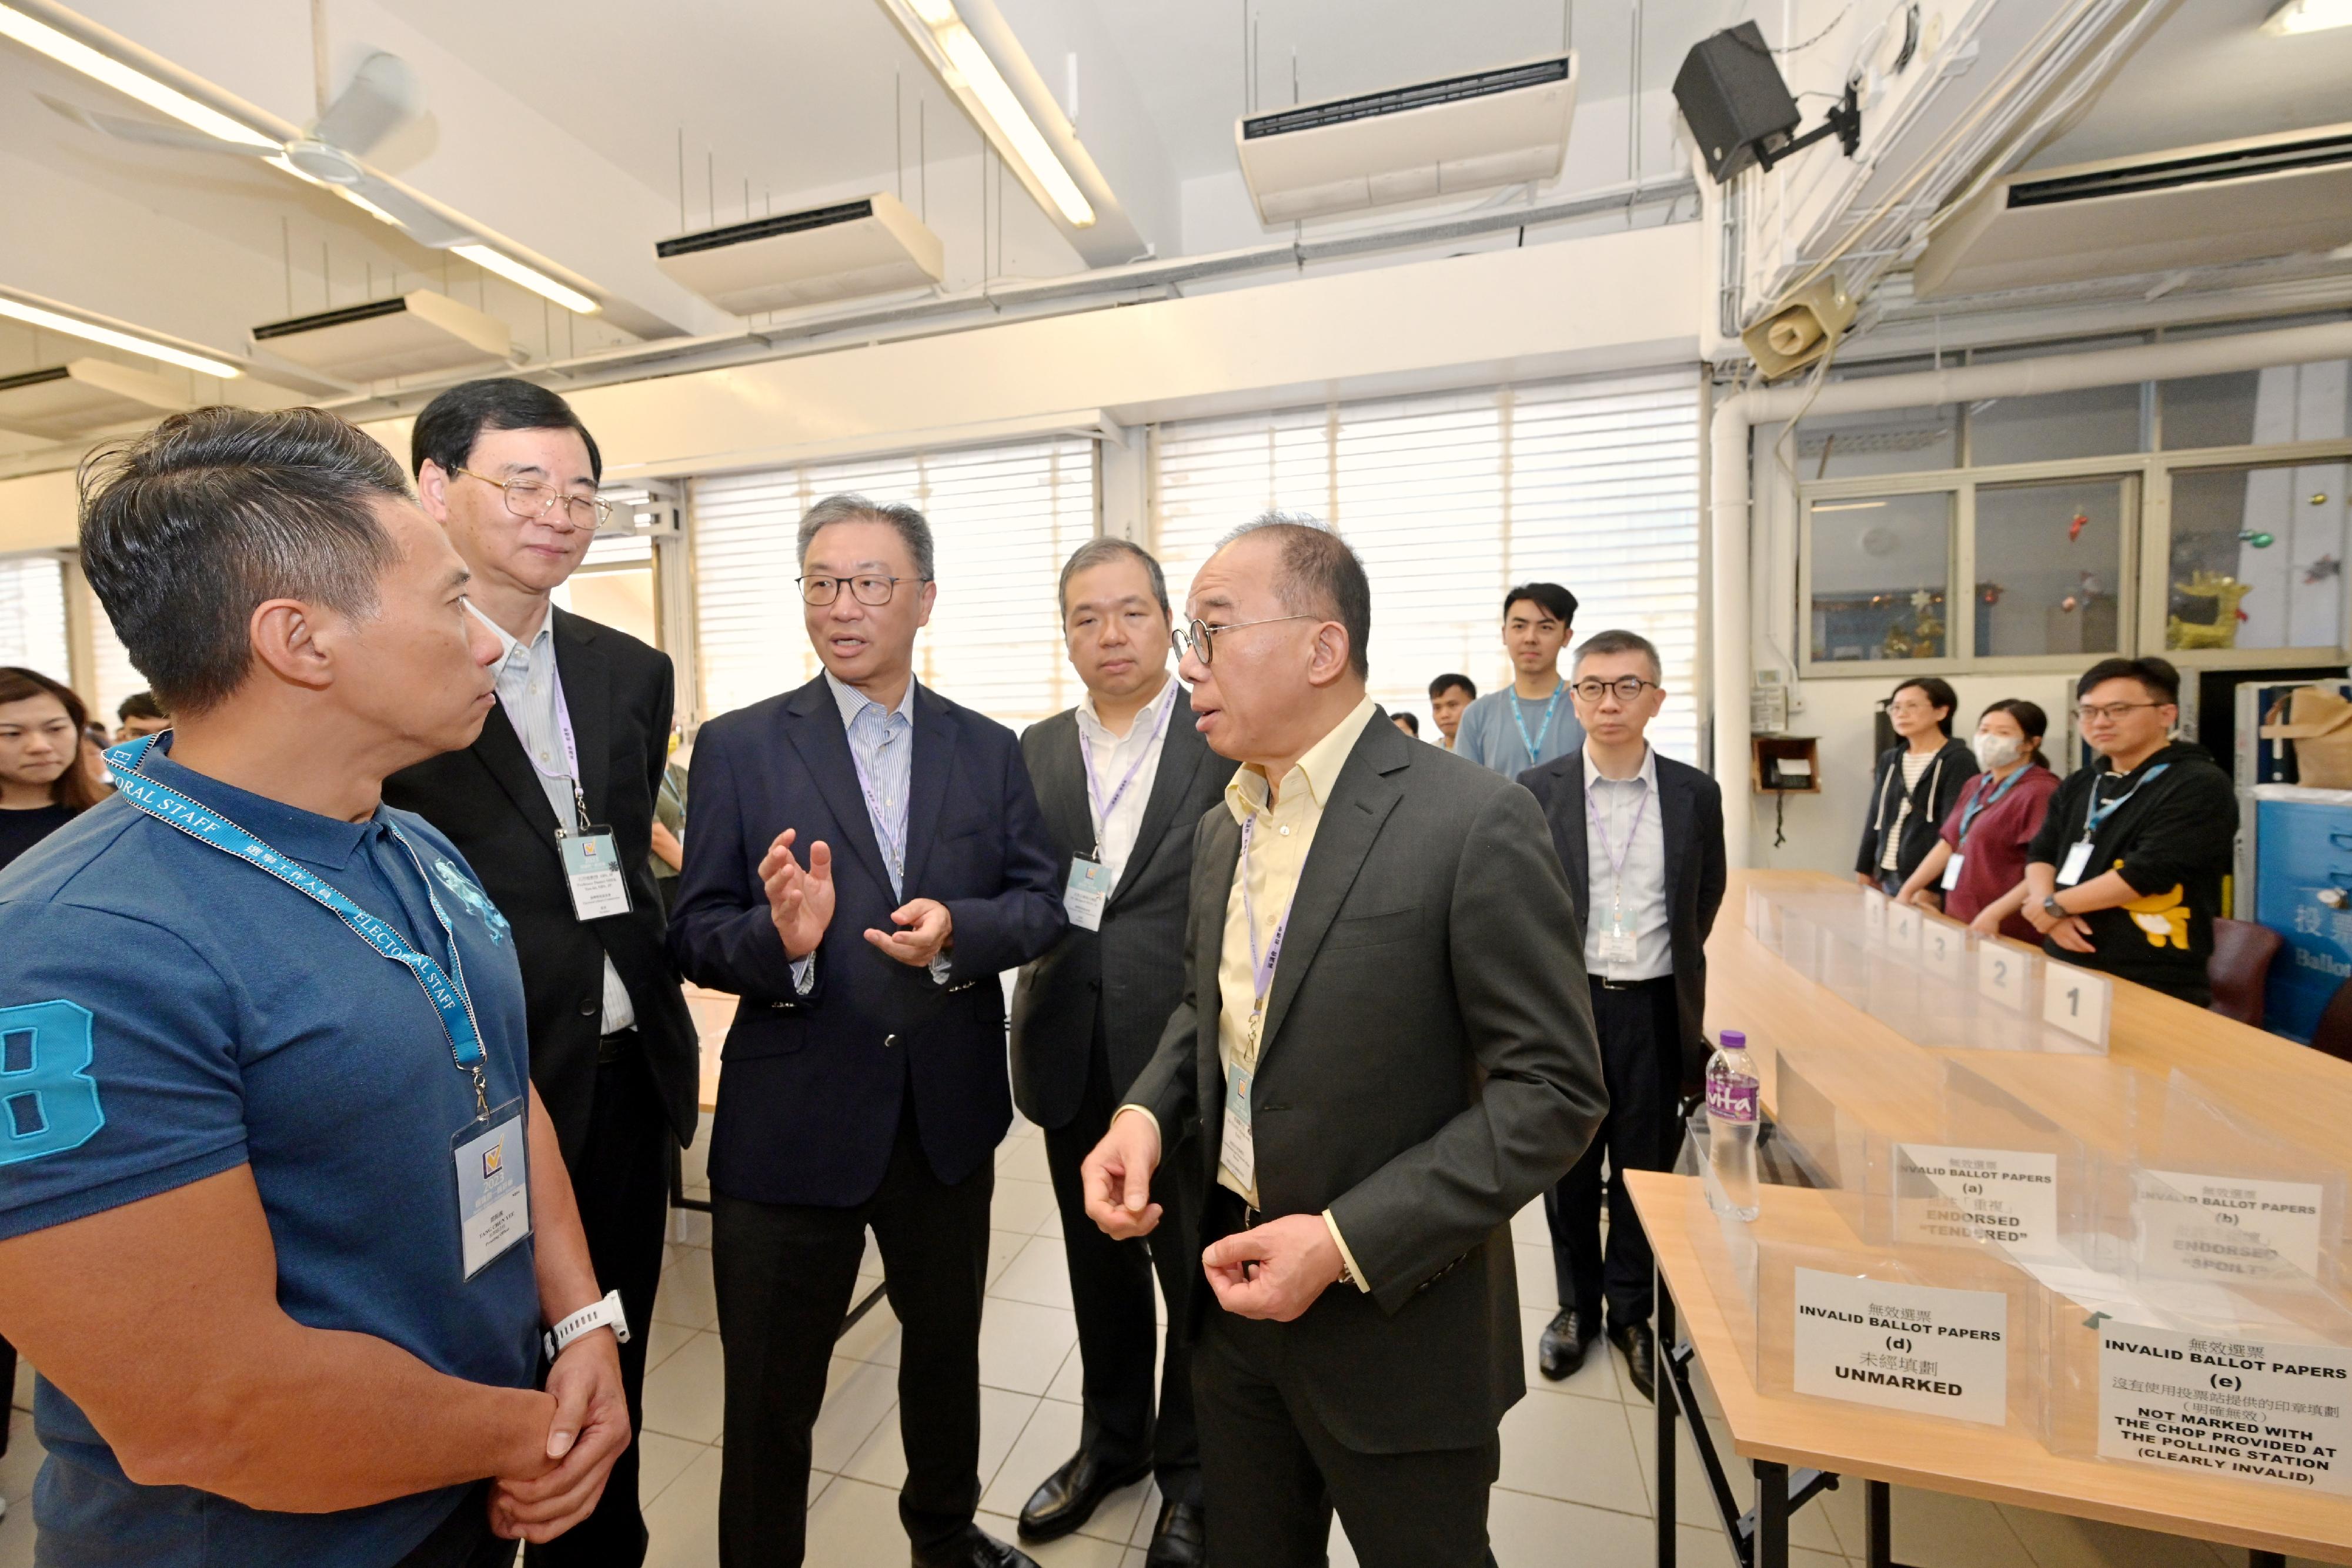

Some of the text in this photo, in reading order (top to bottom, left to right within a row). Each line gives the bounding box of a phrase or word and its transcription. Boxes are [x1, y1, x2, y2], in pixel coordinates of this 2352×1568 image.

[157, 798, 220, 833] STAFF
[243, 844, 332, 900] 選舉工作人員
[1899, 918, 1909, 938] 4
[353, 912, 429, 974] ELECTORAL
[426, 972, 456, 1011] STAFF
[1935, 937, 1945, 962] 3
[1993, 960, 2008, 988] 2
[2066, 986, 2080, 1017] 1
[1708, 1088, 1751, 1114] vita
[1950, 1169, 1998, 1180] BALLOT
[2002, 1172, 2052, 1184] PAPERS
[1962, 1183, 1983, 1195] (a)
[1926, 1209, 2020, 1227] ENDORSED
[2201, 1197, 2257, 1211] BALLOT
[2261, 1202, 2317, 1215] PAPERS
[2214, 1212, 2240, 1226] (b)
[1799, 1305, 2001, 1342] INVALID BALLOT PAPERS
[1867, 1302, 1932, 1323] 無效選票
[1886, 1336, 1912, 1353] (d)
[2187, 1338, 2266, 1360] 無效選票
[1859, 1351, 1939, 1377] 未經填劃
[2105, 1339, 2347, 1380] INVALID BALLOT PAPERS
[1835, 1365, 1963, 1397] UNMARKED
[2210, 1373, 2242, 1392] (e)
[2114, 1416, 2337, 1459] THE CHOP PROVIDED AT
[2137, 1407, 2313, 1442] NOT MARKED WITH
[2121, 1430, 2330, 1471] THE POLLING STATION
[2137, 1447, 2315, 1486] (CLEARLY INVALID)
